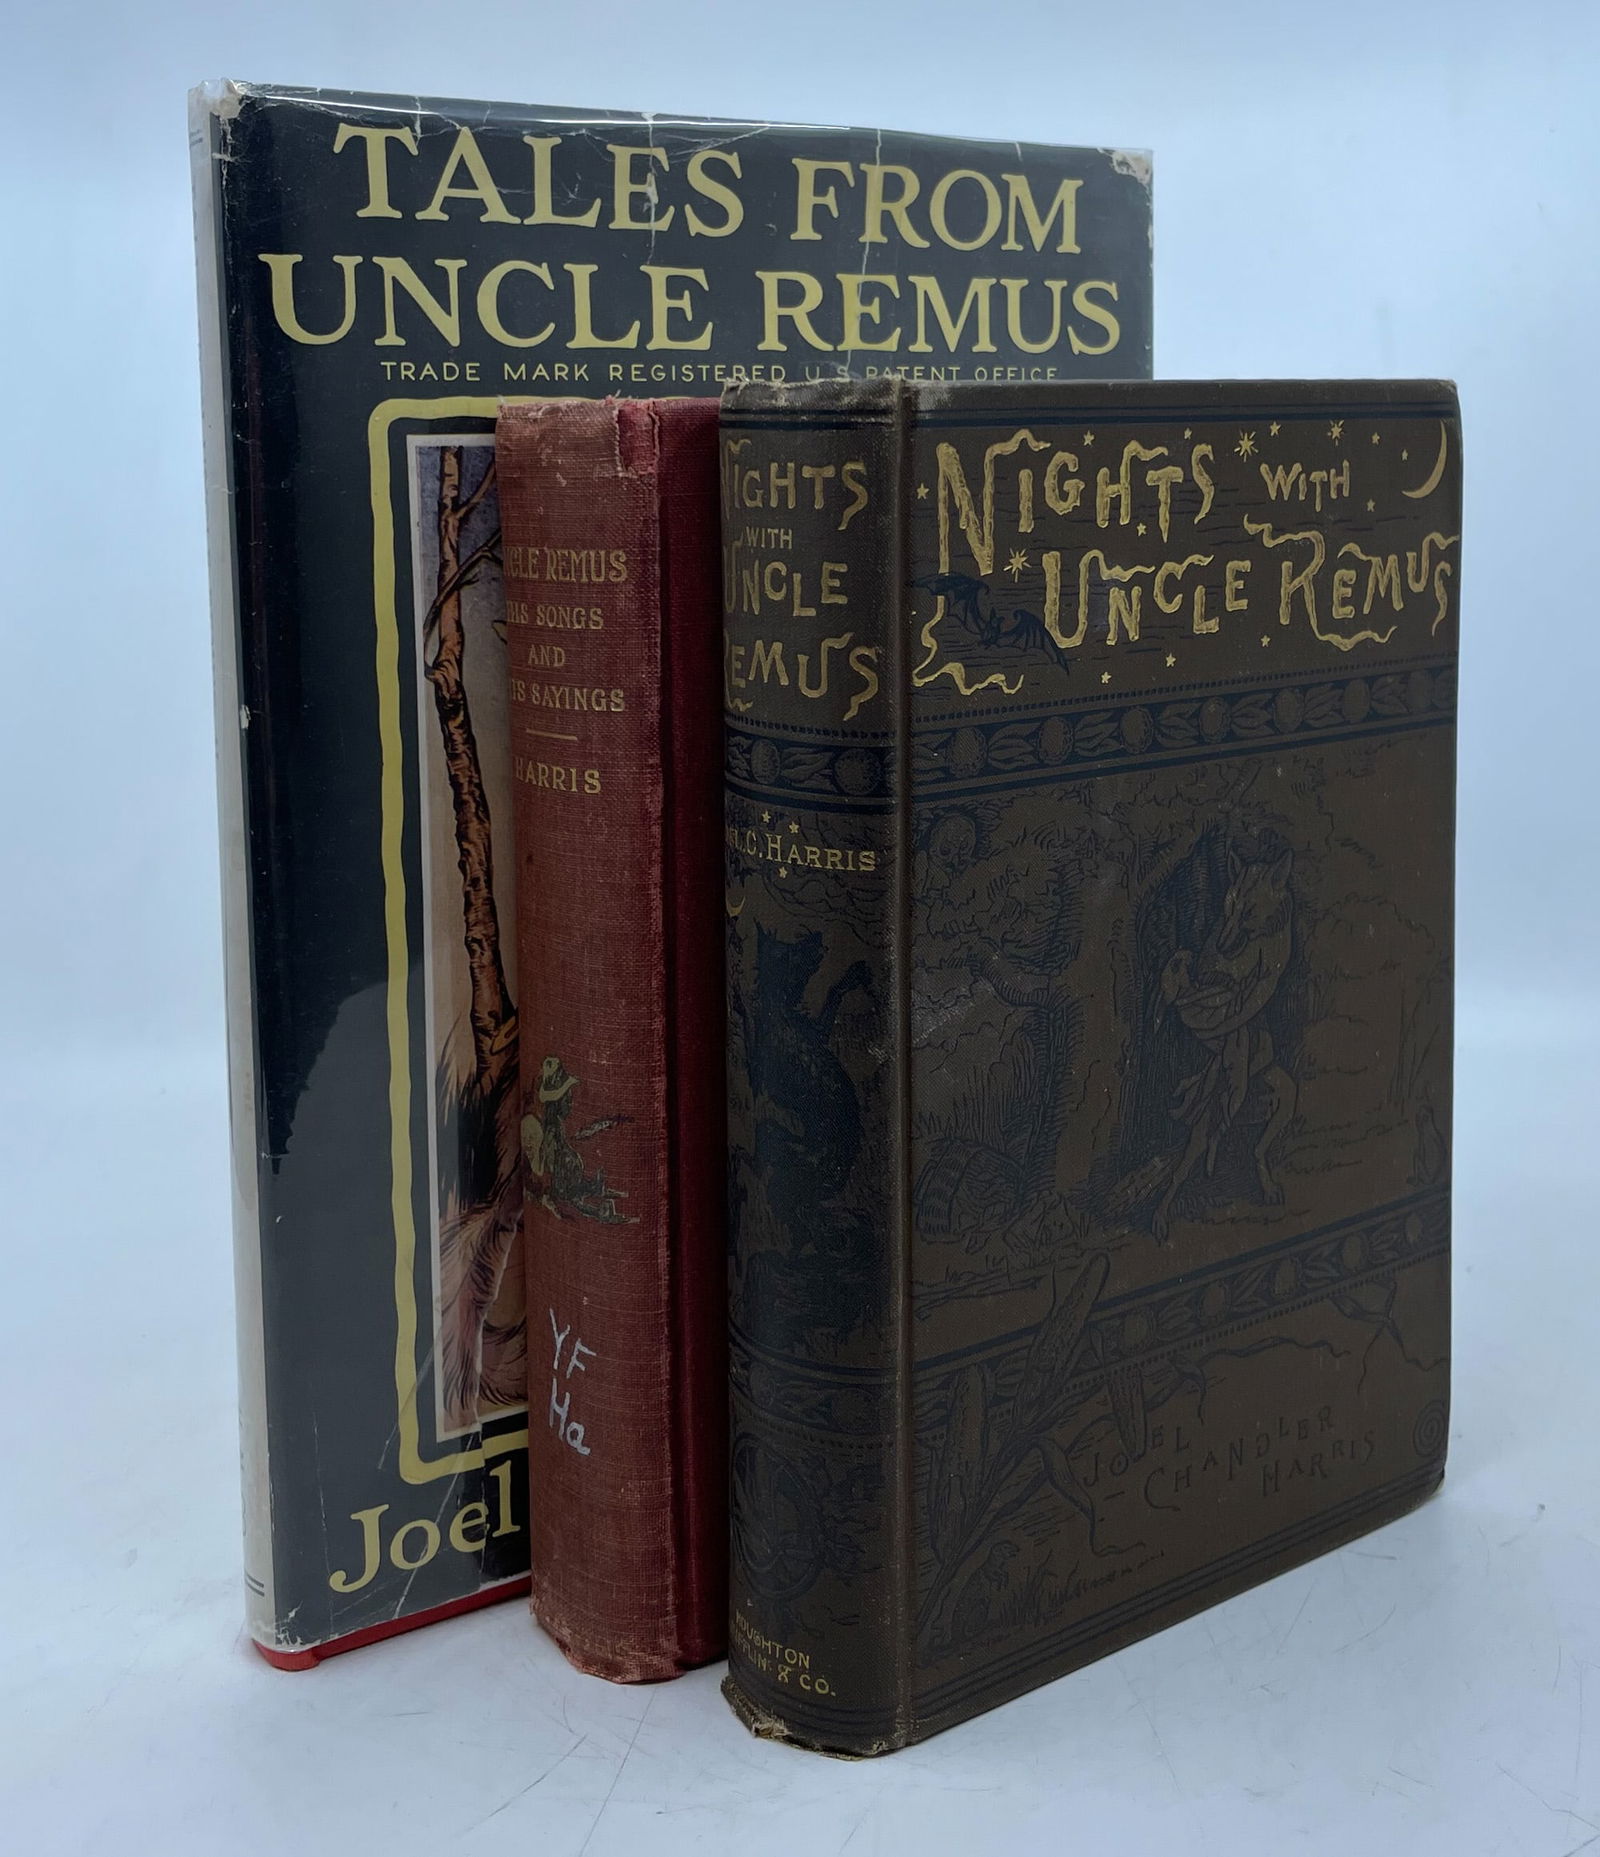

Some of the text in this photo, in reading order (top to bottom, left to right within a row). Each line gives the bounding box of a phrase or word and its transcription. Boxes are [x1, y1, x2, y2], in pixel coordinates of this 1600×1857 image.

[333, 122, 1084, 255] TALES FROM
[258, 253, 1121, 356] UNCLE REMUS
[380, 360, 481, 383] TRADE
[504, 362, 590, 383] MARK
[609, 363, 786, 385] REGISTERED
[866, 366, 961, 382] PATENT
[975, 366, 1058, 382] OFFICE
[937, 429, 1350, 575] NIGHTS WITH
[546, 549, 628, 583] REMUS
[746, 525, 793, 550] WITH
[723, 530, 849, 617] UNCLE
[1042, 515, 1459, 651] UNCLE REMUS
[536, 603, 604, 630] SONGS
[528, 644, 566, 667] AND
[724, 632, 880, 721] EMUS
[532, 683, 626, 712] SAYINGS
[515, 757, 602, 794] HARRIS
[1083, 1426, 1190, 1487] JOEL
[1144, 1405, 1336, 1512] CHANDLER
[1261, 1430, 1375, 1497] HARRIS
[329, 1459, 520, 1593] Joel
[799, 1674, 836, 1696] CO.
